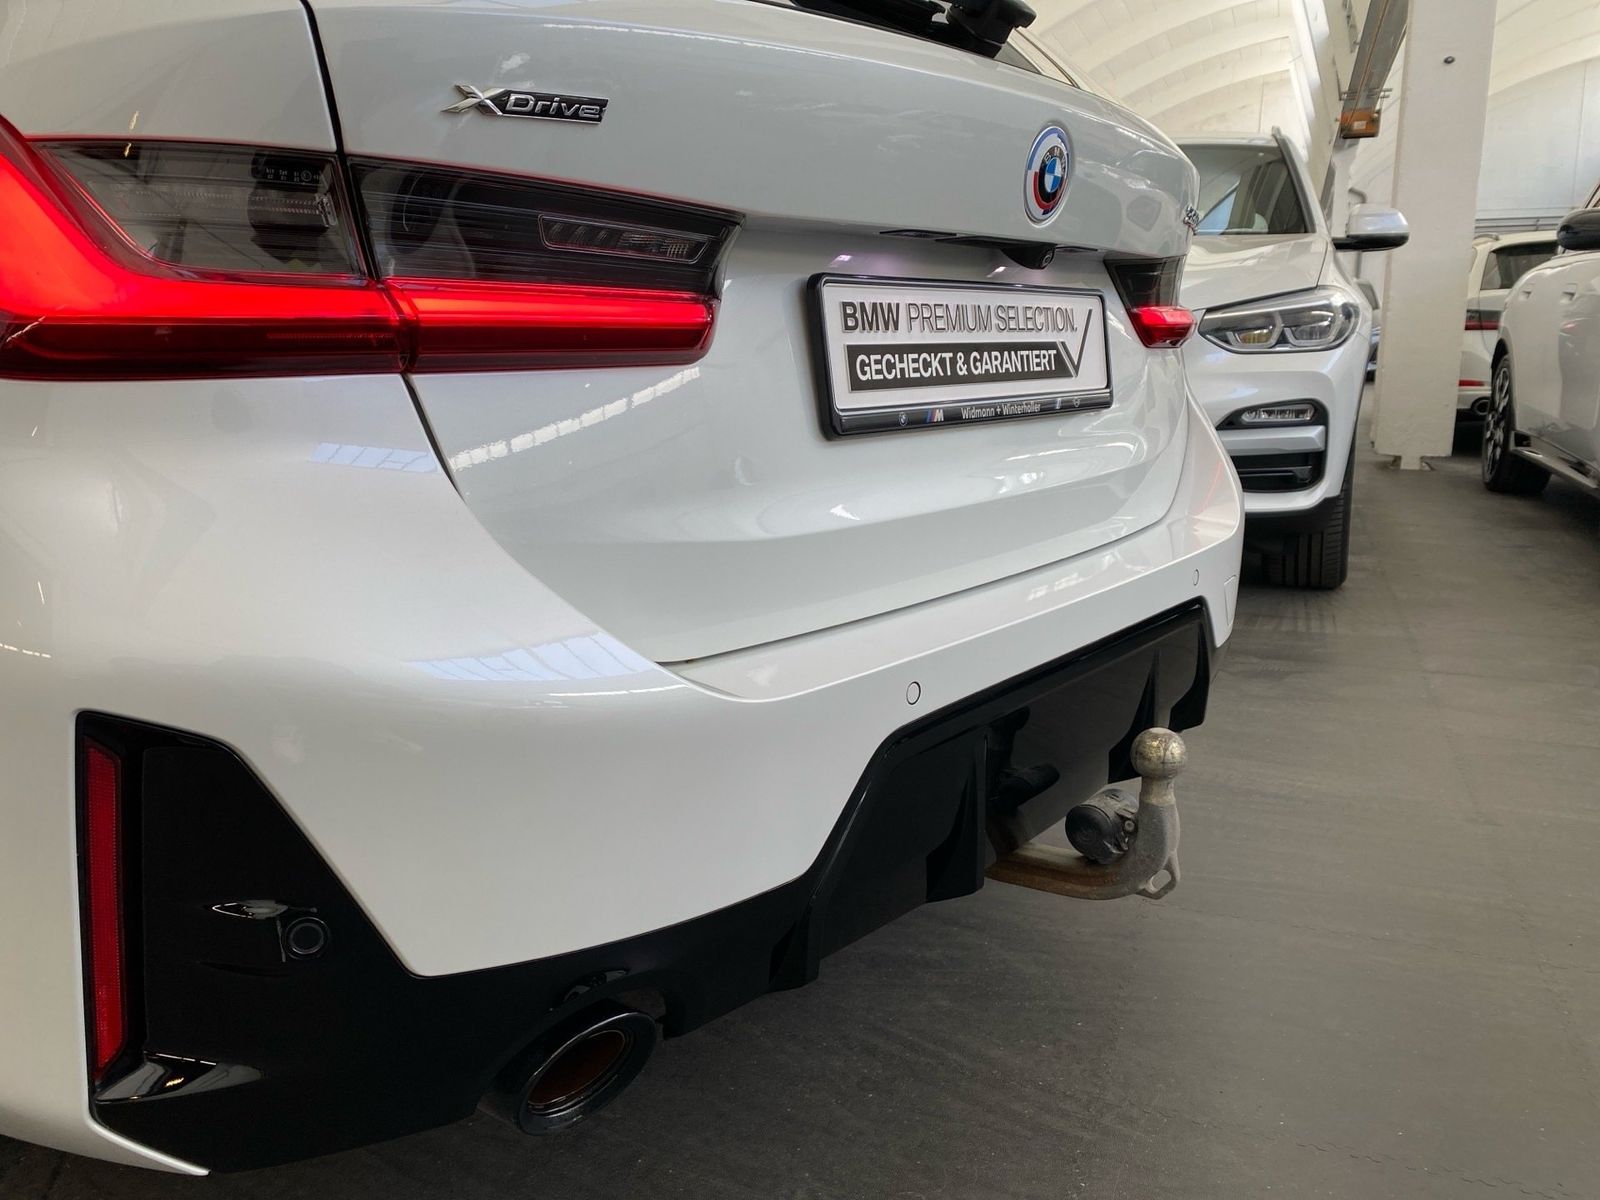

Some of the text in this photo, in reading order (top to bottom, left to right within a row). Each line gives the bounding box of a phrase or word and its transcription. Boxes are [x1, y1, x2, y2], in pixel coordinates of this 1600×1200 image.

[842, 301, 900, 332] BMW
[907, 303, 992, 332] PREMIUM
[856, 350, 1057, 381] GECHECKT & GARANTIERT
[961, 407, 994, 420] Widmann
